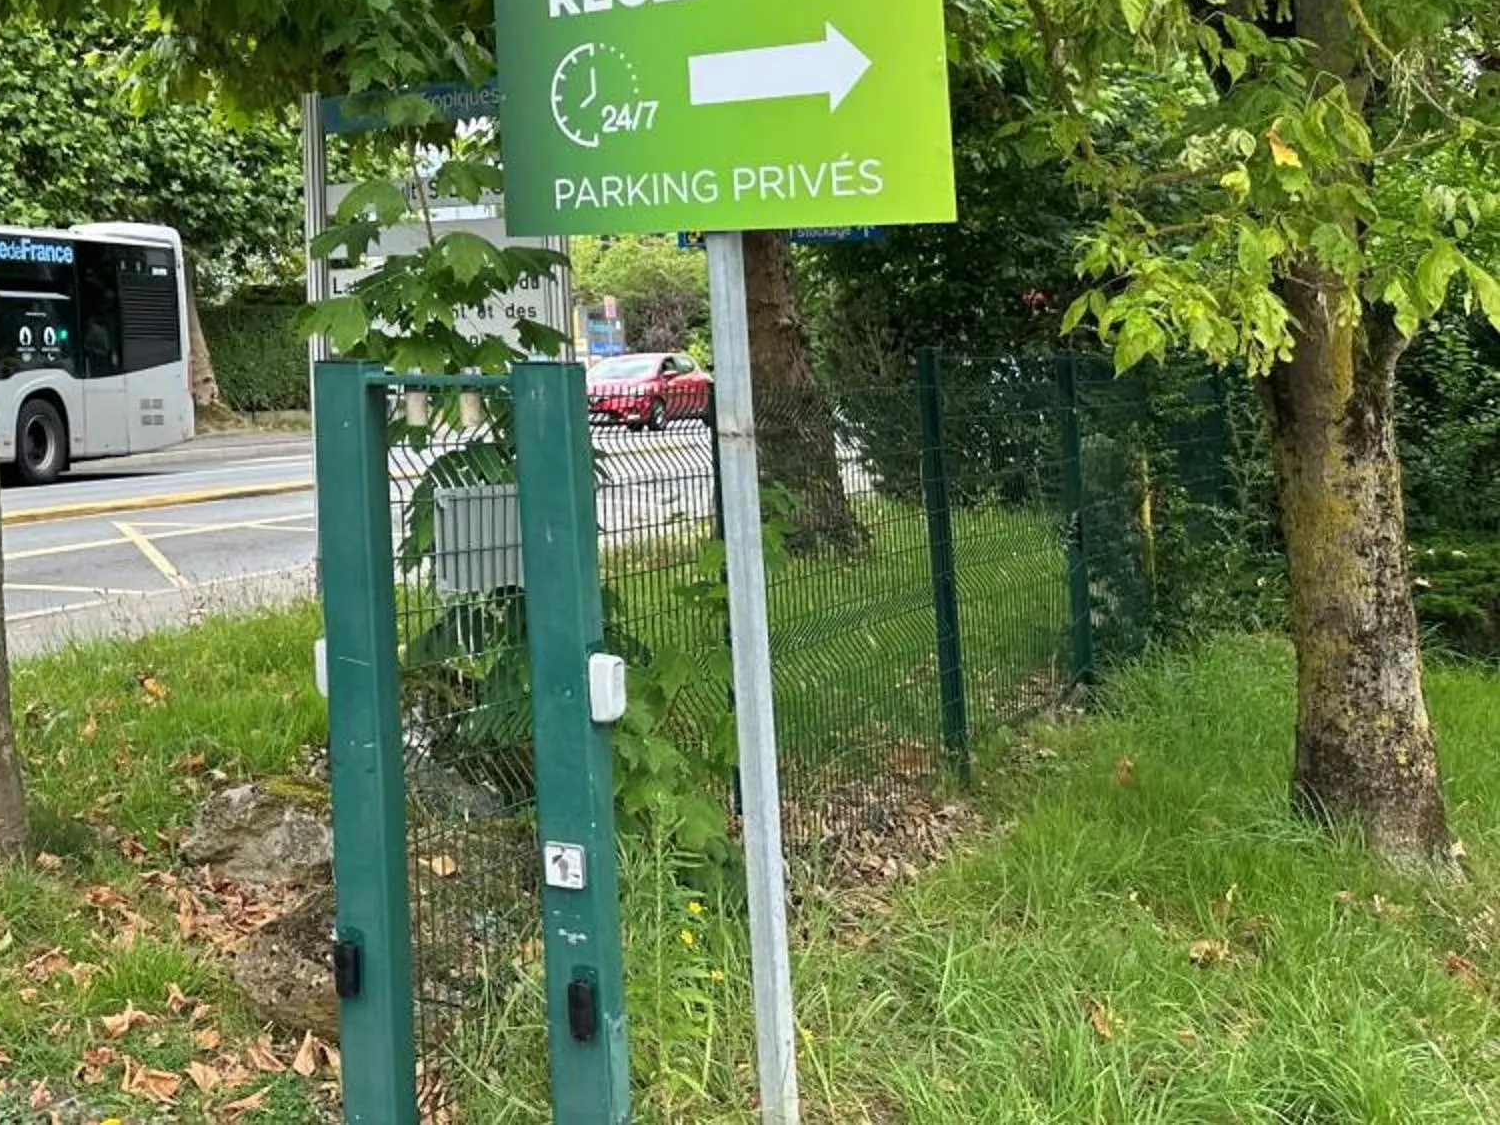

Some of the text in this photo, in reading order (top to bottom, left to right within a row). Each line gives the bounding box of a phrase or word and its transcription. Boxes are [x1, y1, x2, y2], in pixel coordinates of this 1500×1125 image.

[601, 100, 660, 133] 24/7
[554, 169, 719, 211] PARKING
[732, 152, 884, 201] PRIVÉS
[505, 303, 538, 318] des
